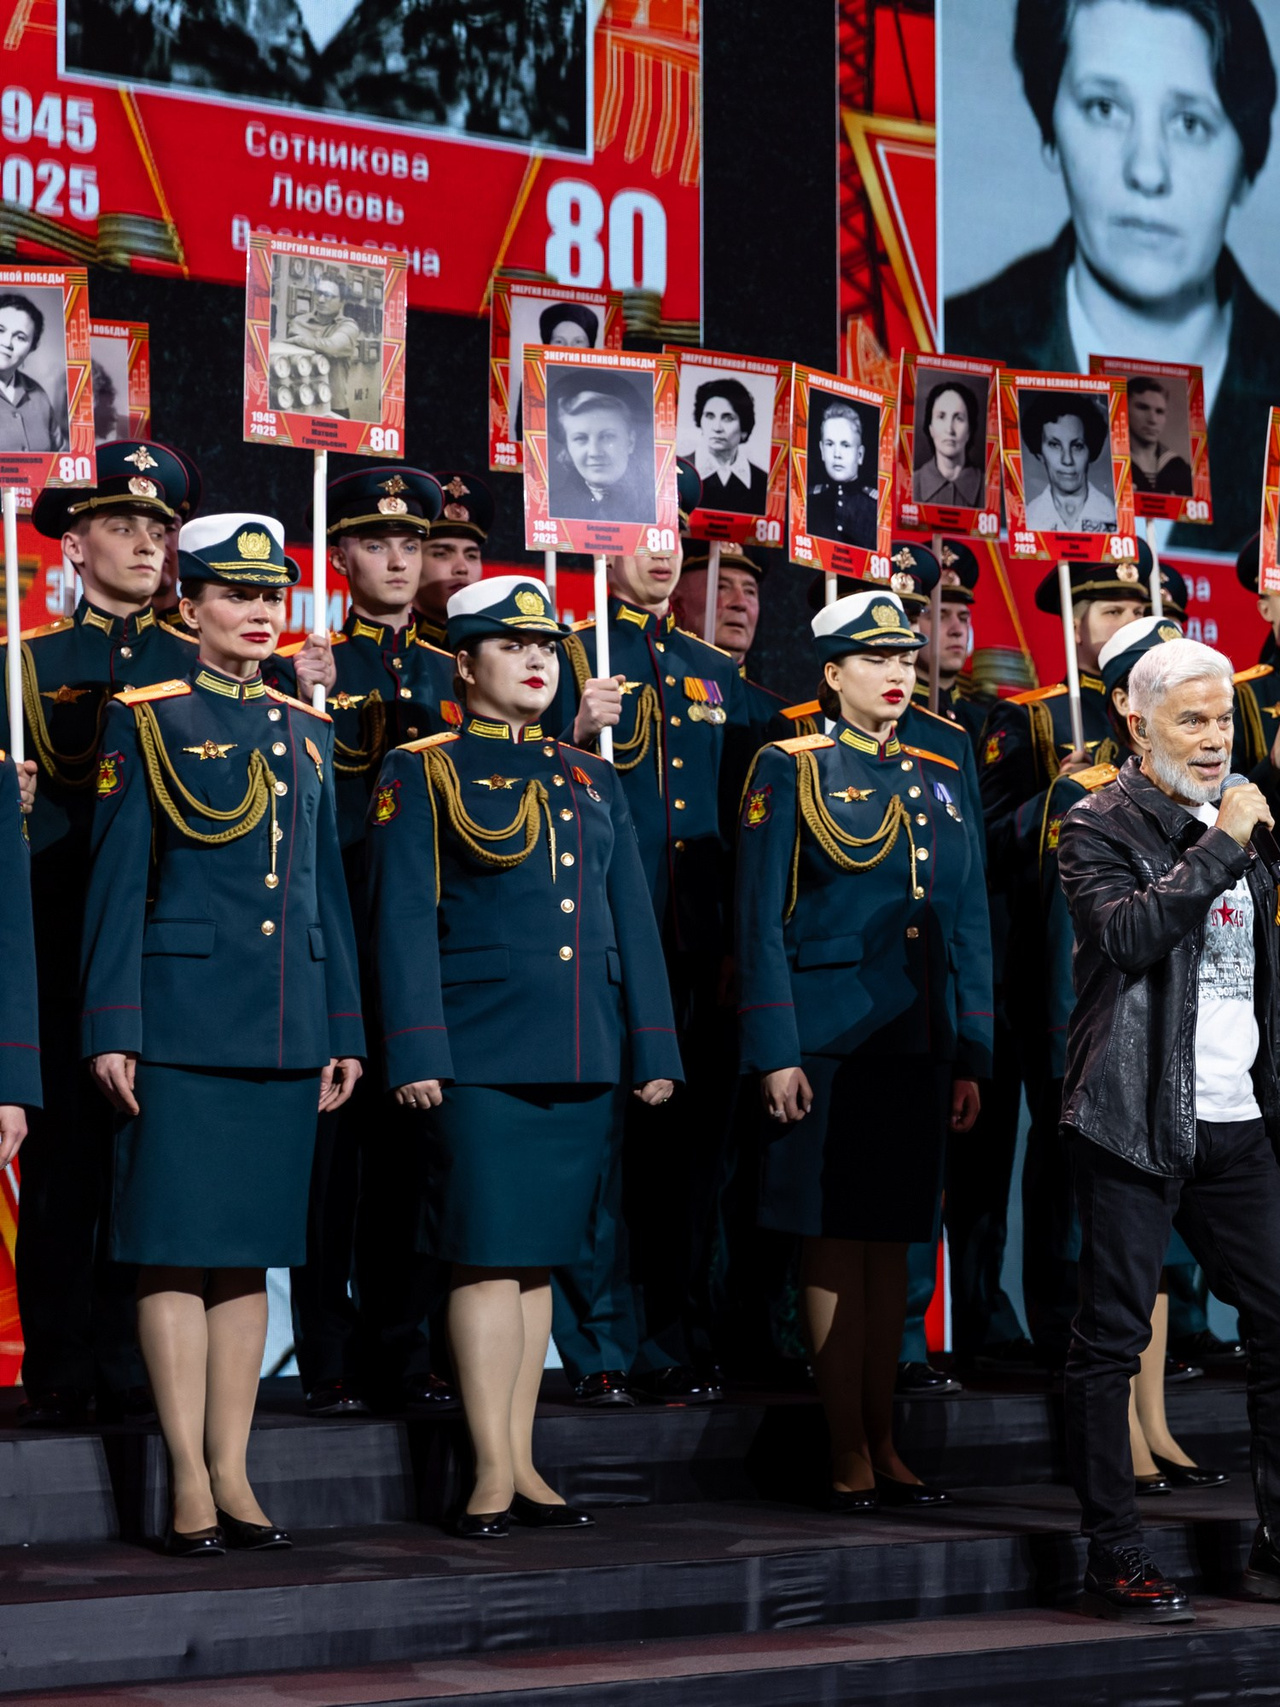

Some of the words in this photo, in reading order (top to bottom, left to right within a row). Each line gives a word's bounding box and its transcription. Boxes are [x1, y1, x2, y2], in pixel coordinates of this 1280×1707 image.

[2, 85, 97, 154] 945
[245, 120, 429, 182] Сотникова
[0, 153, 100, 221] 025
[269, 172, 404, 225] Любовь
[545, 176, 667, 298] 80
[270, 240, 308, 253] ЭНЕРГИЯ
[309, 246, 348, 260] ВЕЛИКОЙ
[350, 252, 388, 265] ПОБЕДЫ
[23, 272, 65, 284] ПОБЕДЫ
[510, 283, 541, 296] ЭНЕРГИЯ
[542, 287, 575, 300] ВЕЛИКОЙ
[576, 291, 607, 304] ПОБЕДЫ
[93, 324, 129, 337] ПОБЕДЫ
[544, 350, 580, 362] ЭНЕРГИЯ
[581, 353, 618, 366] ВЕЛИКОЙ
[619, 356, 656, 368] ПОБЕДЫ
[681, 352, 712, 365] ЭНЕРГИЯ
[713, 357, 746, 370] ВЕЛИКОЙ
[747, 361, 779, 374] ПОБЕДЫ
[808, 373, 832, 388] ЭНЕРГИЯ
[833, 380, 858, 396] ВЕЛИКОЙ
[858, 387, 883, 403] ПОБЕДЫ
[1015, 375, 1046, 387] ЭНЕРГИЯ
[1047, 376, 1079, 389] ВЕЛИКОЙ
[1080, 379, 1110, 391] ПОБЕДЫ
[251, 411, 276, 424] 1945
[250, 424, 277, 437] 2025
[370, 427, 399, 451] 80
[495, 443, 516, 454] 1945
[59, 456, 91, 483] 80
[494, 454, 517, 466] 2025
[1186, 500, 1209, 520] 80
[533, 519, 557, 531] 1945
[755, 519, 780, 541] 80
[978, 512, 997, 534] 80
[532, 532, 558, 544] 2025
[646, 528, 675, 552] 80
[795, 535, 812, 548] 1945
[1014, 532, 1035, 543] 1945
[1110, 536, 1135, 559] 80
[794, 547, 813, 560] 2025
[1014, 543, 1036, 555] 2025
[870, 554, 890, 578] 80
